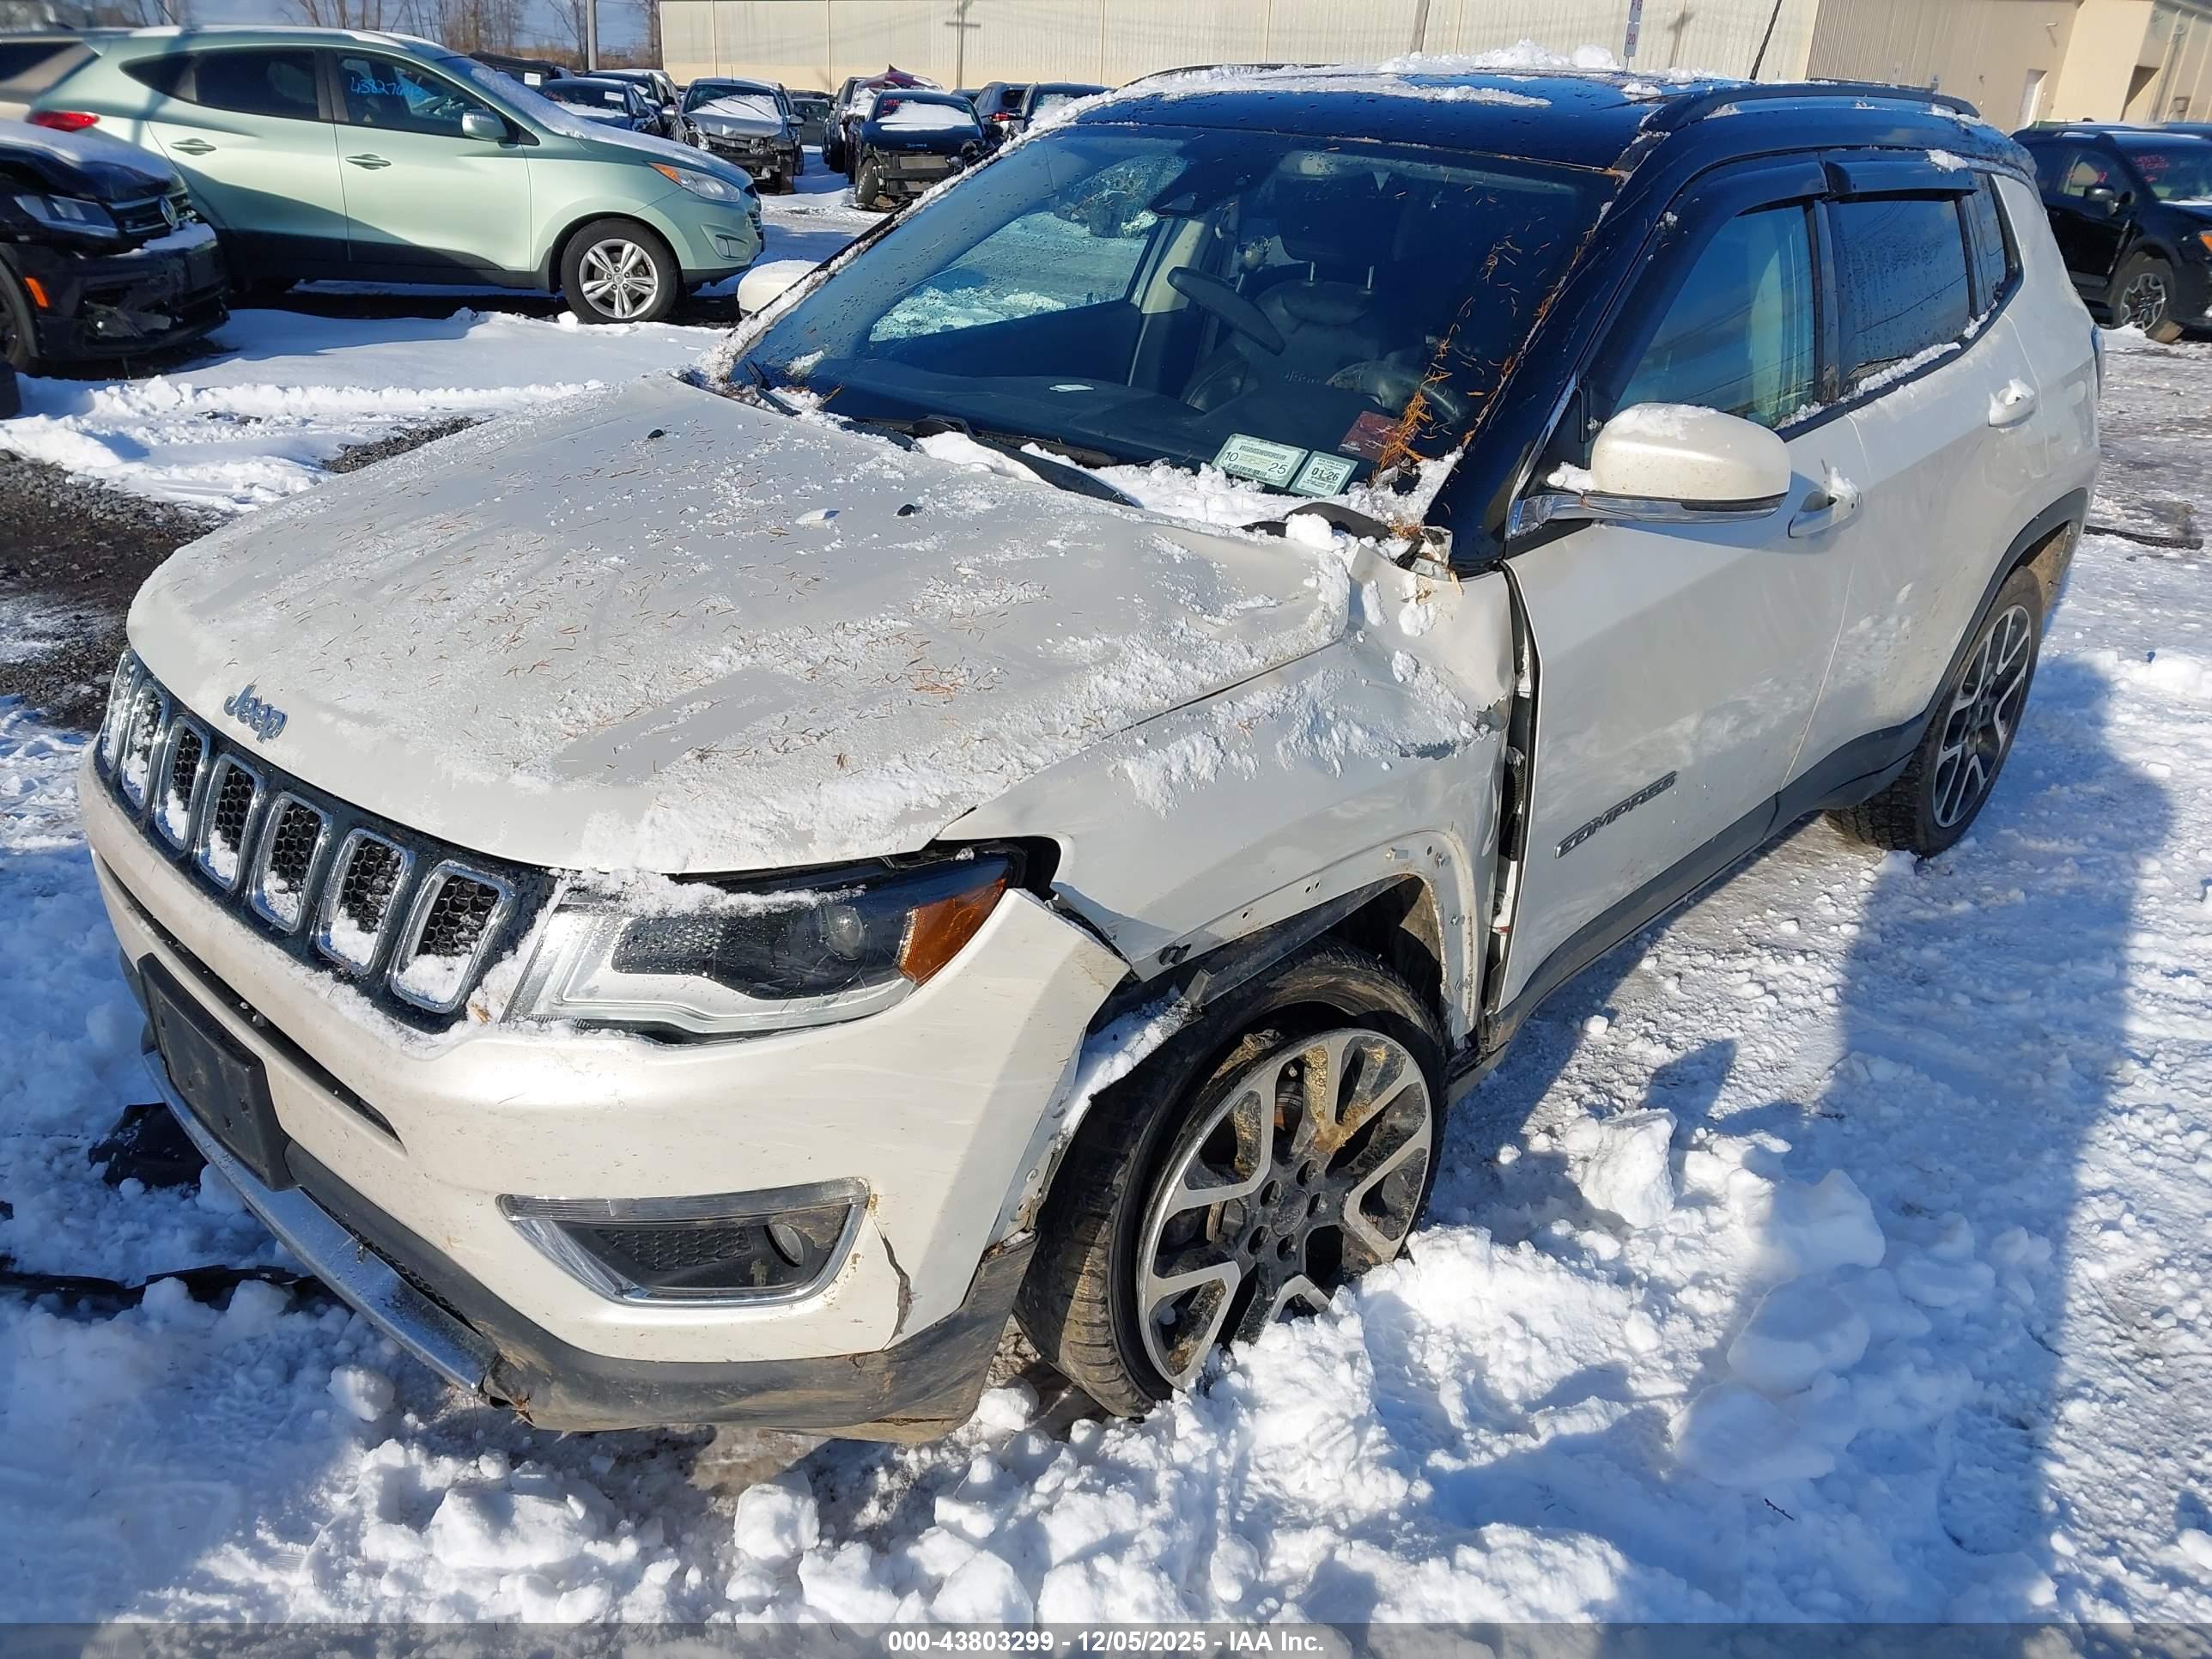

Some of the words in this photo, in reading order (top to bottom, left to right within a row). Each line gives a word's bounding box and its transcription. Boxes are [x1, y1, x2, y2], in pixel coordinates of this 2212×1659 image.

[1627, 33, 1636, 45] 20
[1224, 451, 1239, 462] 10
[1267, 462, 1289, 475] 25
[223, 684, 289, 744] Jeep
[1553, 770, 1678, 859] COMPASS
